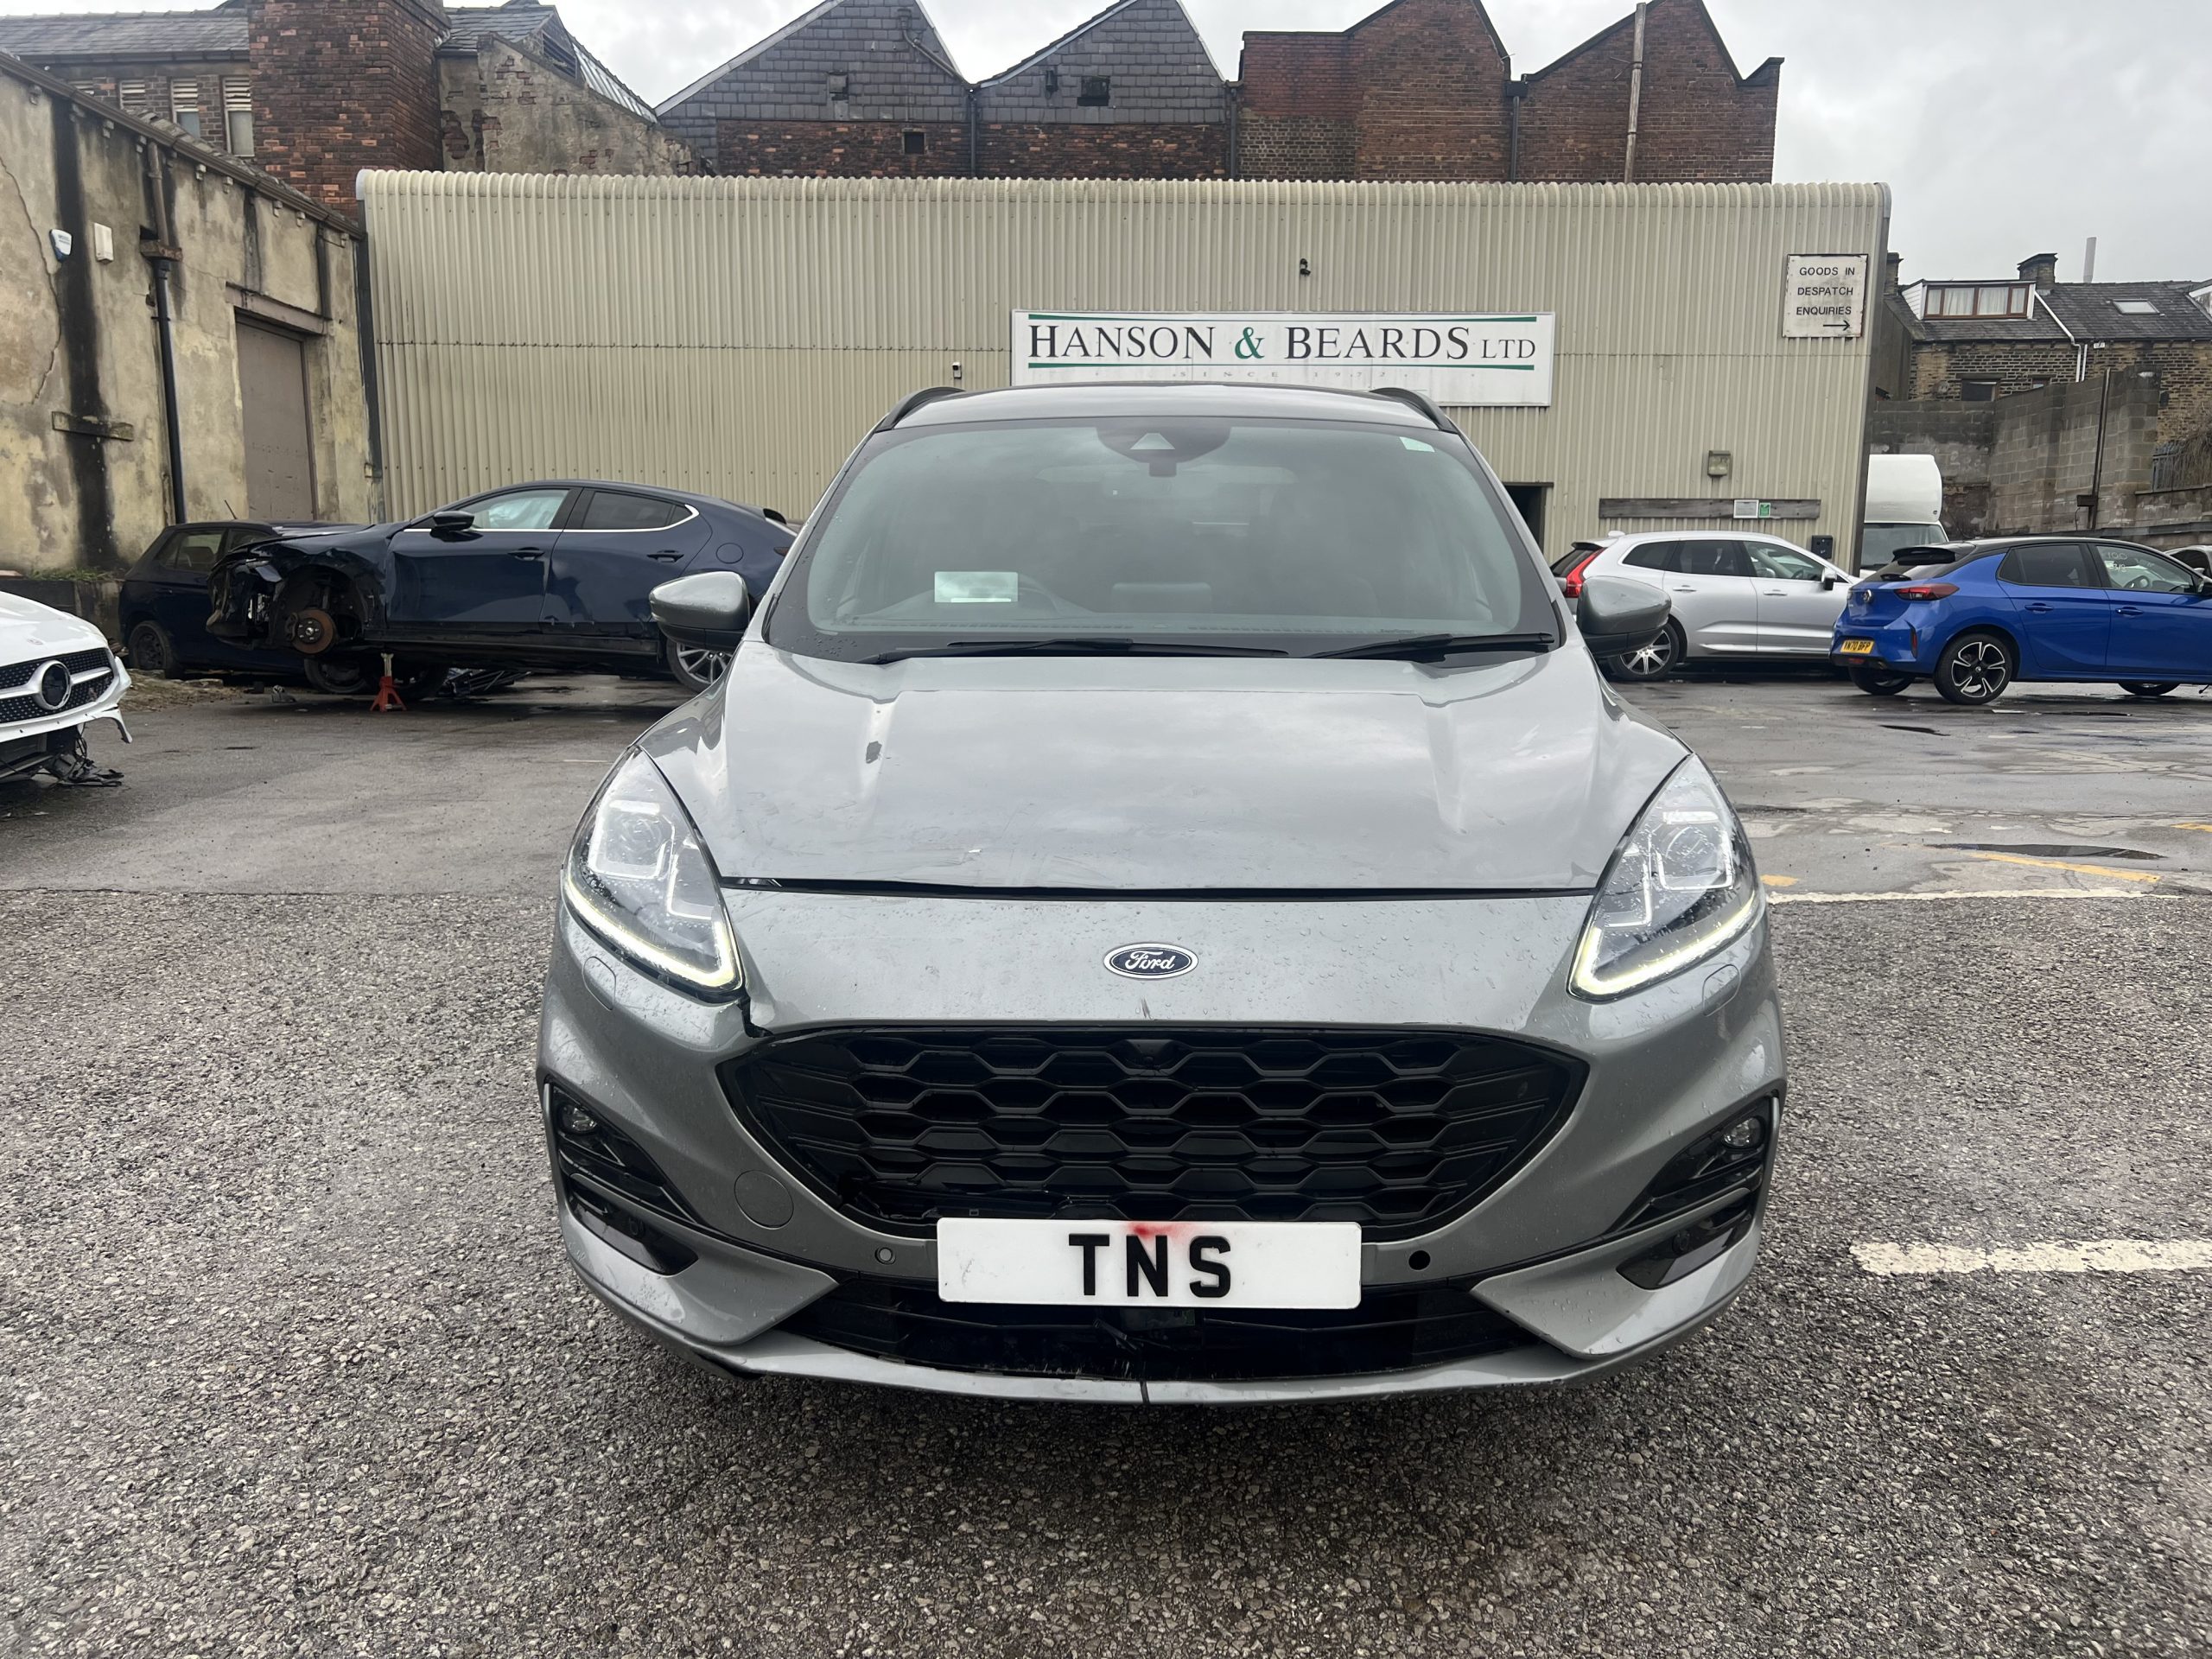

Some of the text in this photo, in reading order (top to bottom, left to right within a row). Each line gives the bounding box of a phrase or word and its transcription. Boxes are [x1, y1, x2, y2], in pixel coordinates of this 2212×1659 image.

[1799, 267, 1855, 276] GOODS IN
[1797, 287, 1853, 296] DESPATCH
[1796, 306, 1852, 315] ENQUIRIES
[1028, 325, 1535, 359] HANSON & BEARDS LTD
[1124, 950, 1176, 969] Ford
[1068, 1233, 1231, 1299] TNS
